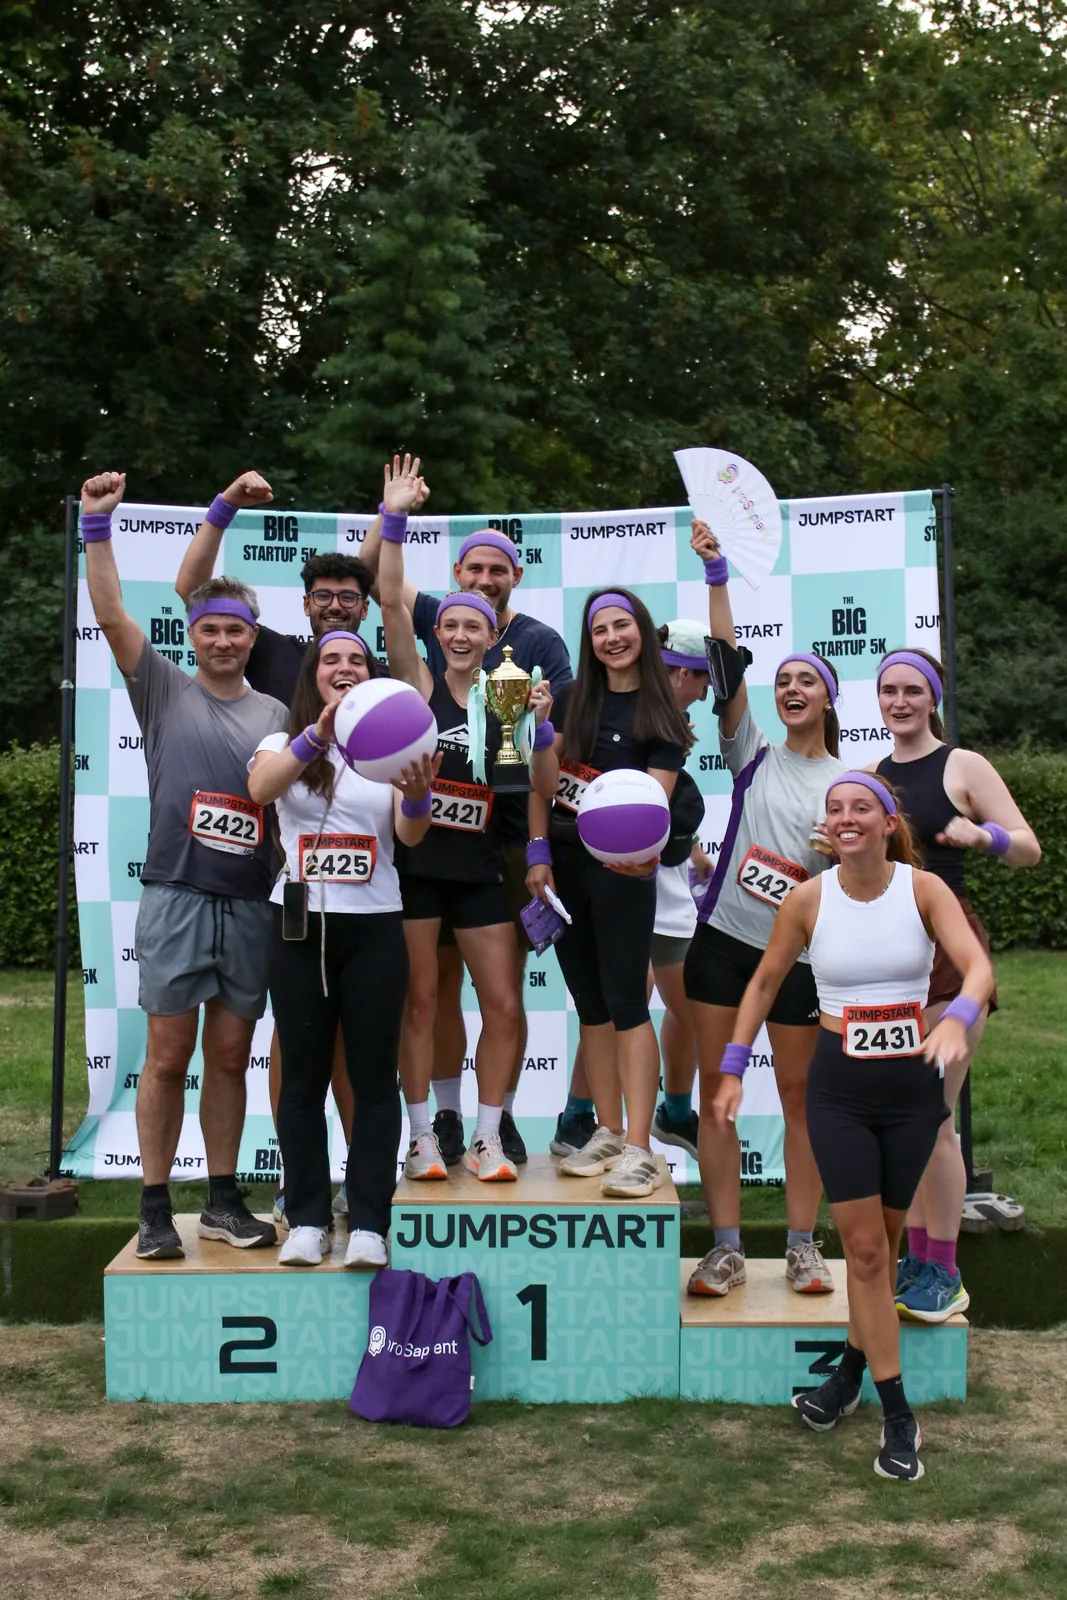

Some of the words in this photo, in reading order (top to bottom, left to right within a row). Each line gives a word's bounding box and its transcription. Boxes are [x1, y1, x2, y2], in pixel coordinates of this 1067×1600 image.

[799, 508, 895, 526] JUMPSTART
[264, 516, 298, 542] BIG
[346, 530, 440, 543] JUTART
[571, 522, 666, 540] JUMPSTART
[243, 545, 297, 562] STARTUP
[301, 547, 318, 563] 5K
[526, 549, 542, 563] 5K
[151, 618, 184, 645] BIG
[735, 624, 783, 639] START
[832, 607, 867, 635] BIG
[812, 640, 866, 656] STARTUP
[870, 638, 887, 654] 5K
[839, 728, 891, 742] PSTAR
[439, 742, 456, 751] IKE
[431, 781, 488, 799] UMPSTART
[197, 794, 258, 816] JUMPSTART
[431, 798, 483, 825] 2421
[197, 810, 256, 841] 2422
[752, 848, 809, 881] JUMPSTAR
[742, 865, 796, 900] 242
[530, 972, 547, 987] 5K
[848, 1006, 917, 1020] JUMPSTART
[853, 1025, 915, 1051] 2431
[741, 1152, 763, 1175] IG
[397, 1213, 675, 1249] JUMPSTART
[516, 1284, 547, 1360] 1
[219, 1316, 277, 1374] 2
[387, 1339, 458, 1359] roSapent
